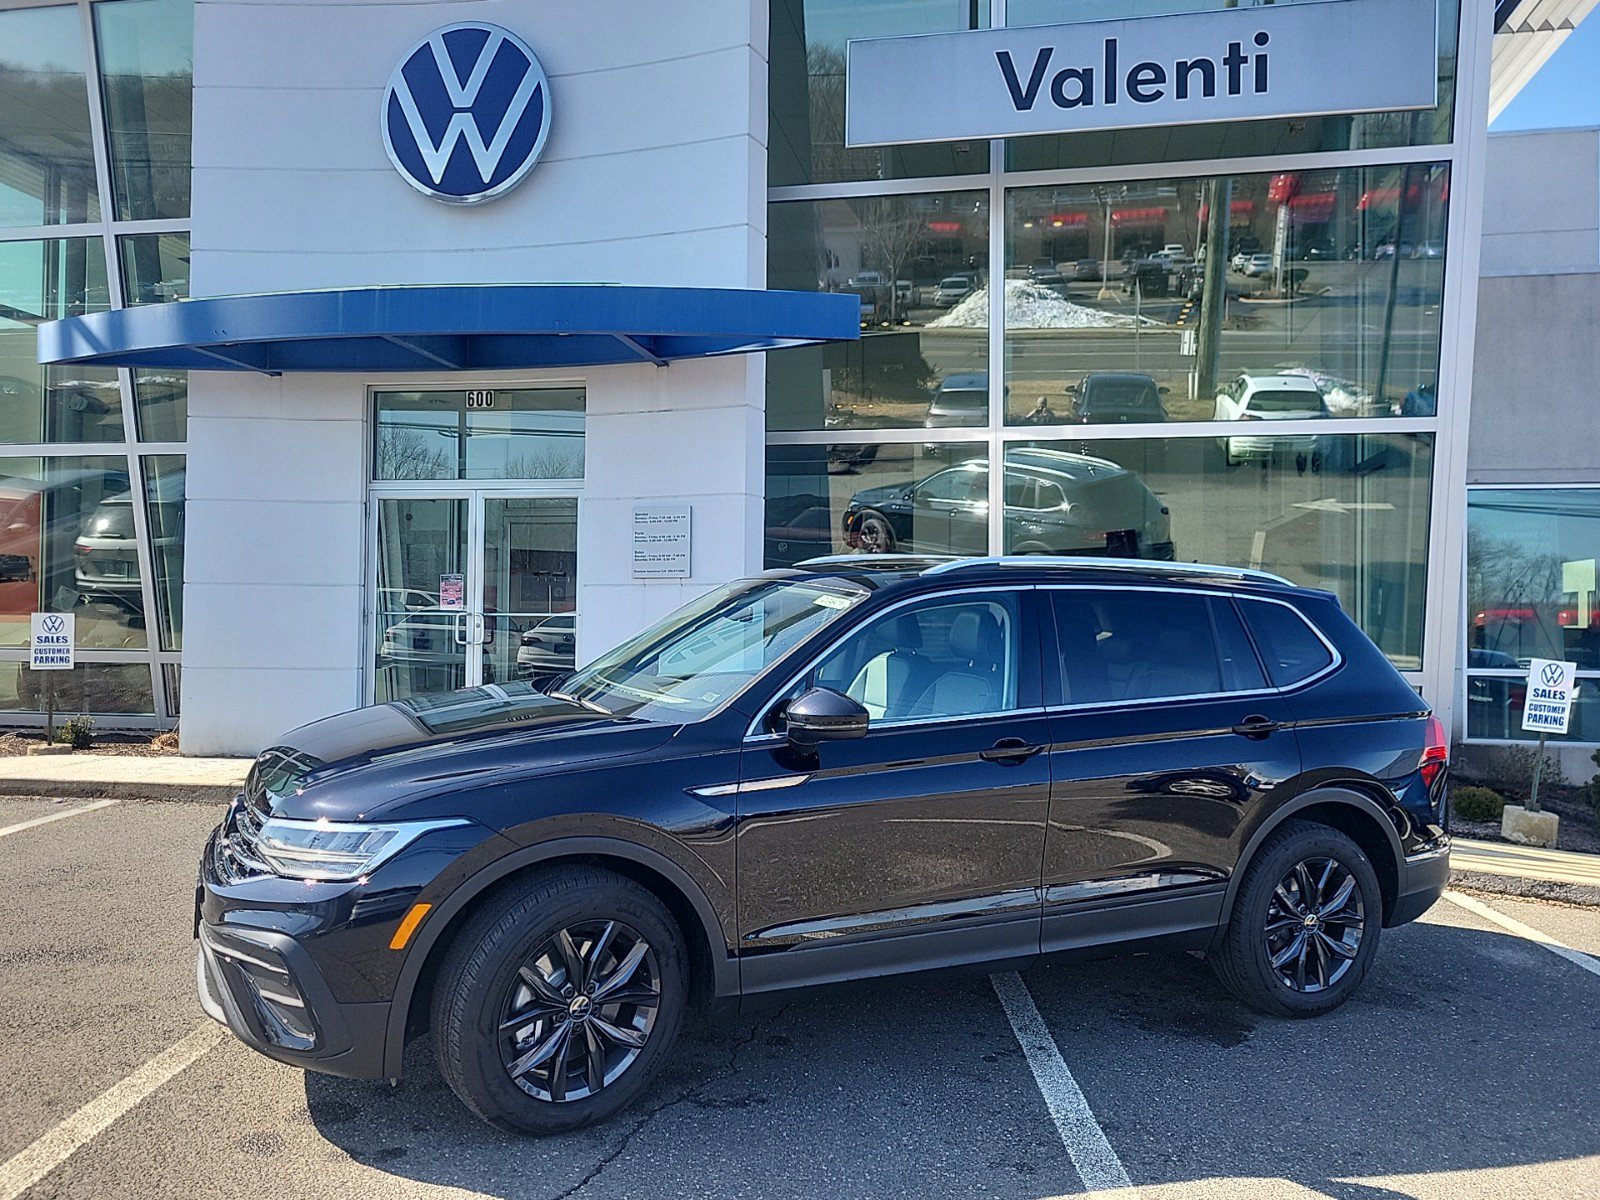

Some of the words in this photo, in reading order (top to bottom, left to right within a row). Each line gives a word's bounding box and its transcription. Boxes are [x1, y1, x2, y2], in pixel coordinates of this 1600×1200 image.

[995, 31, 1270, 112] Valenti
[468, 391, 493, 407] 600
[36, 635, 68, 644] SALES
[34, 647, 70, 655] CUSTOMER
[34, 656, 70, 664] PARKING
[1533, 688, 1566, 700] SALES
[1528, 703, 1566, 714] CUSTOMER
[1527, 712, 1565, 726] PARKING
